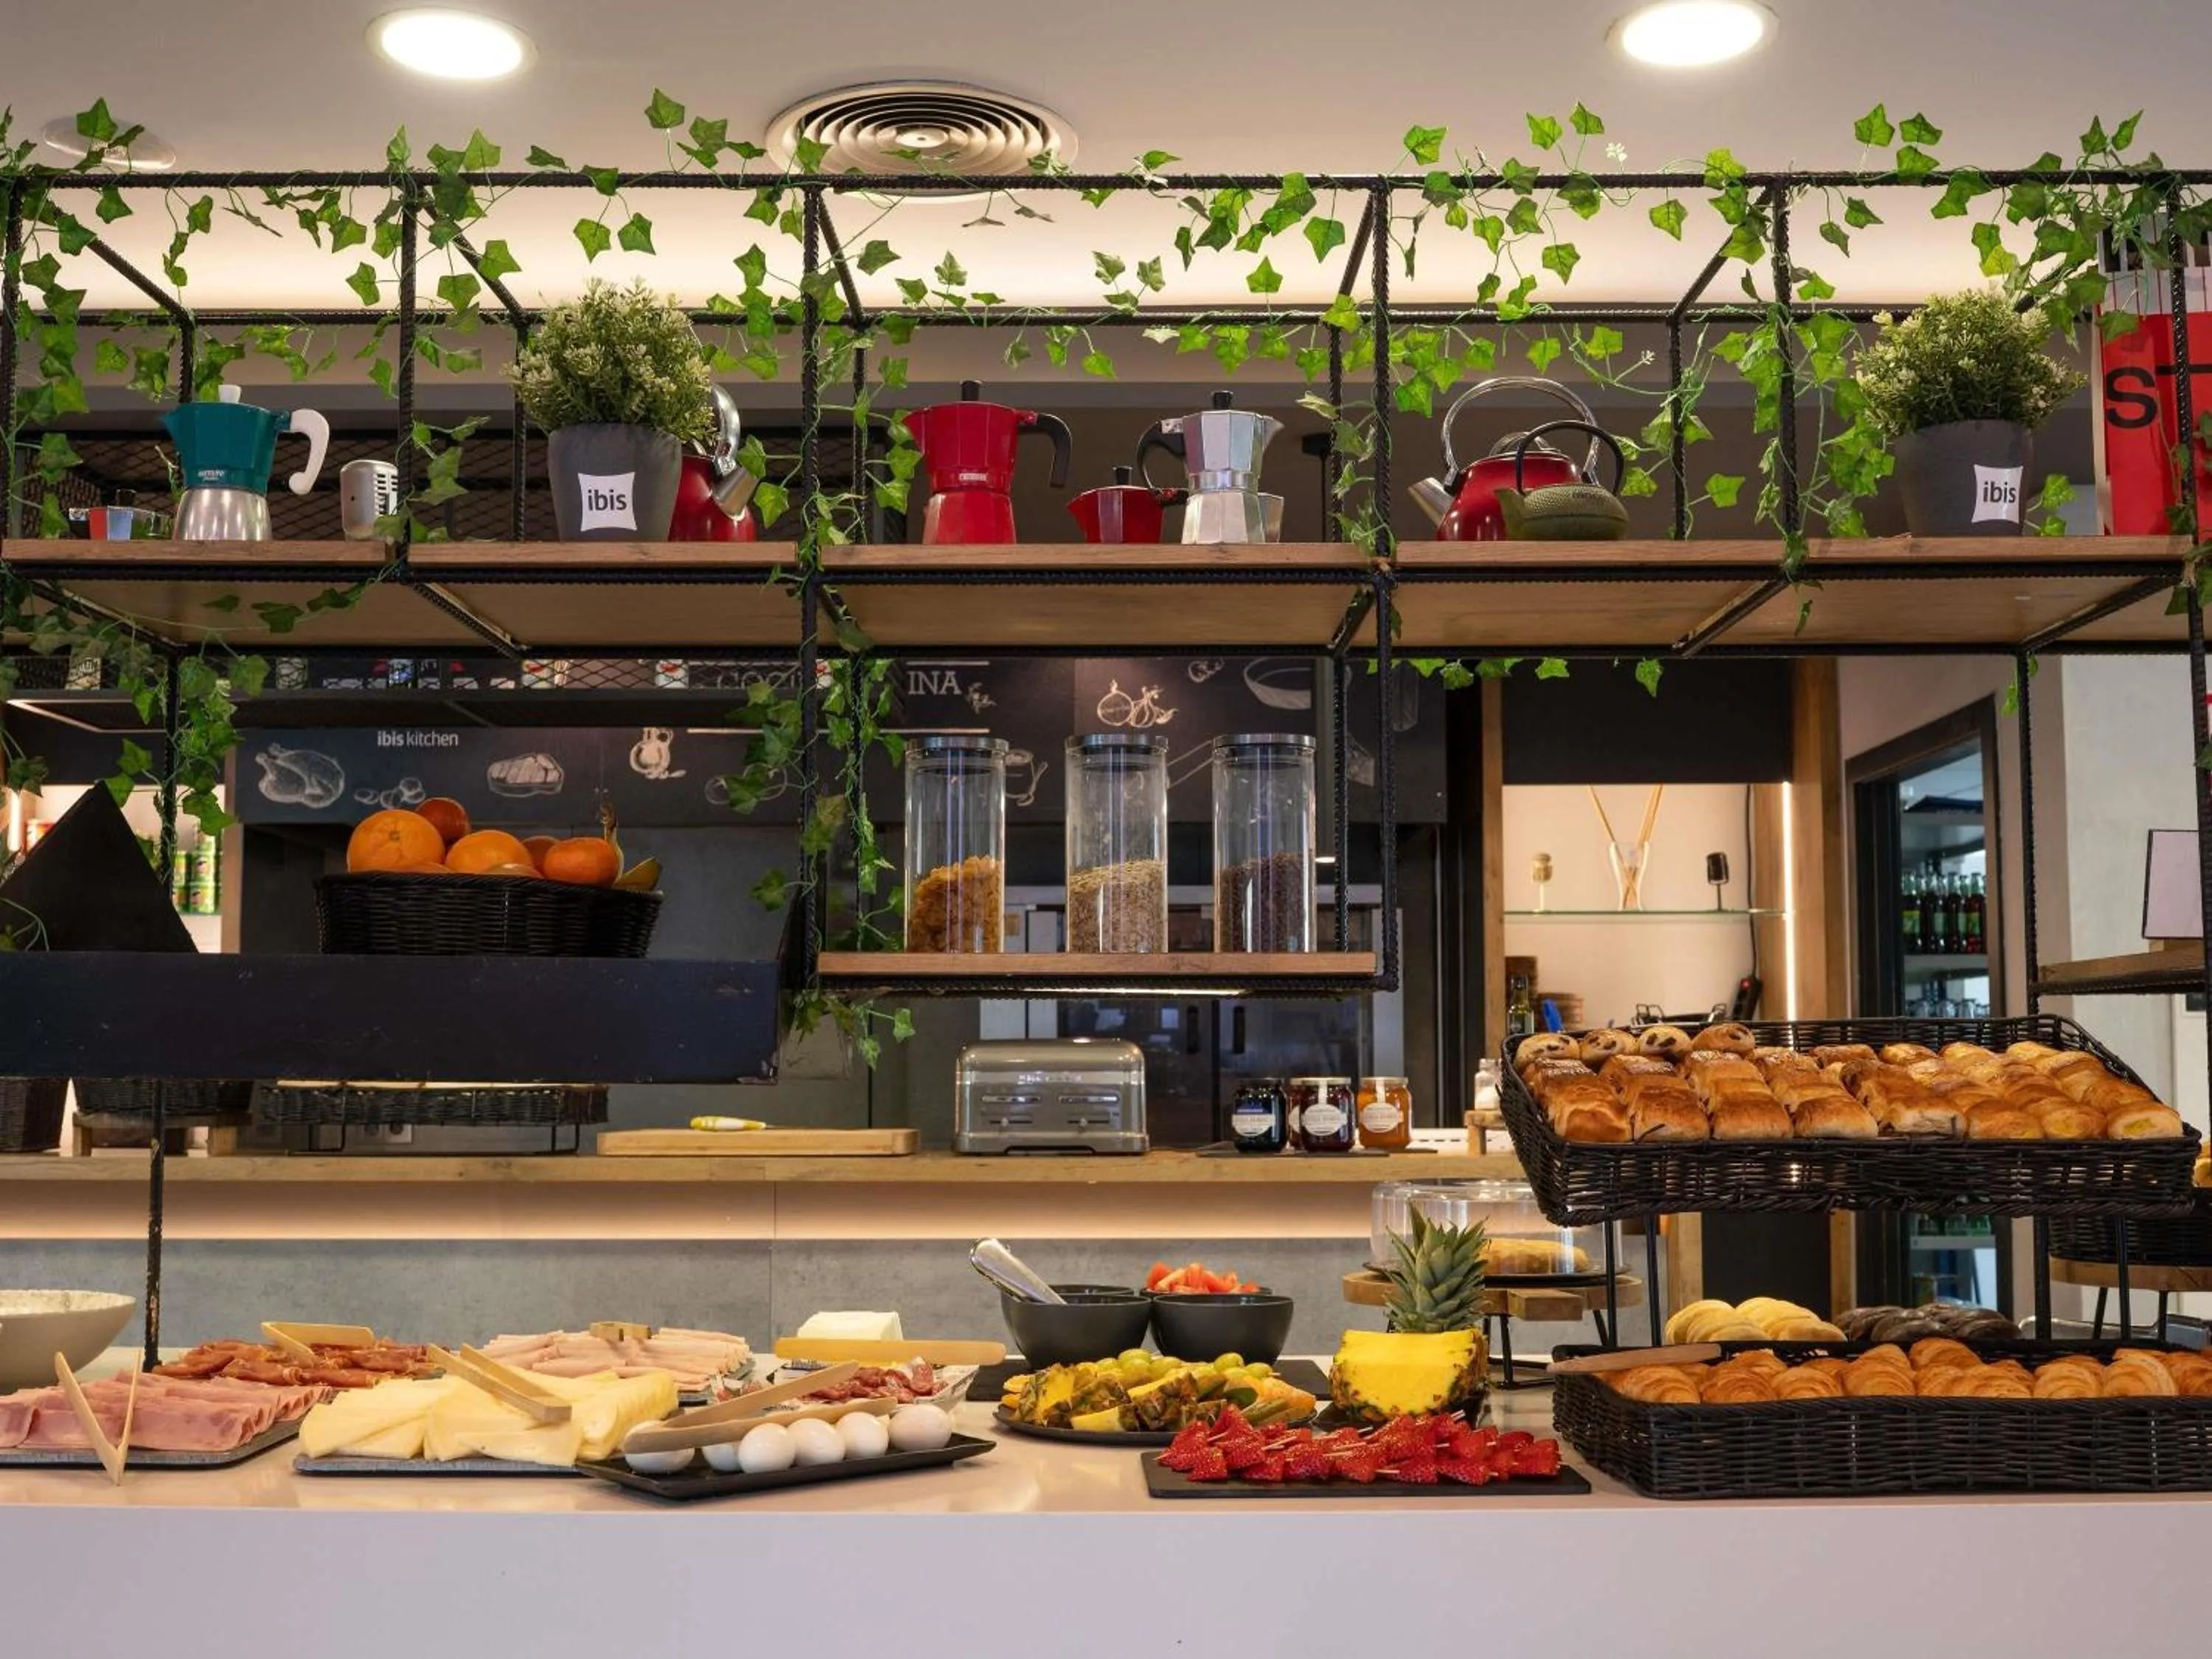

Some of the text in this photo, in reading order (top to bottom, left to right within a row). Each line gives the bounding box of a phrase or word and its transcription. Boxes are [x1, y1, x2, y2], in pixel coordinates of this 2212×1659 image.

[588, 489, 627, 511] ibis
[1983, 481, 2017, 504] ibis
[377, 730, 459, 747] ibis kitchen
